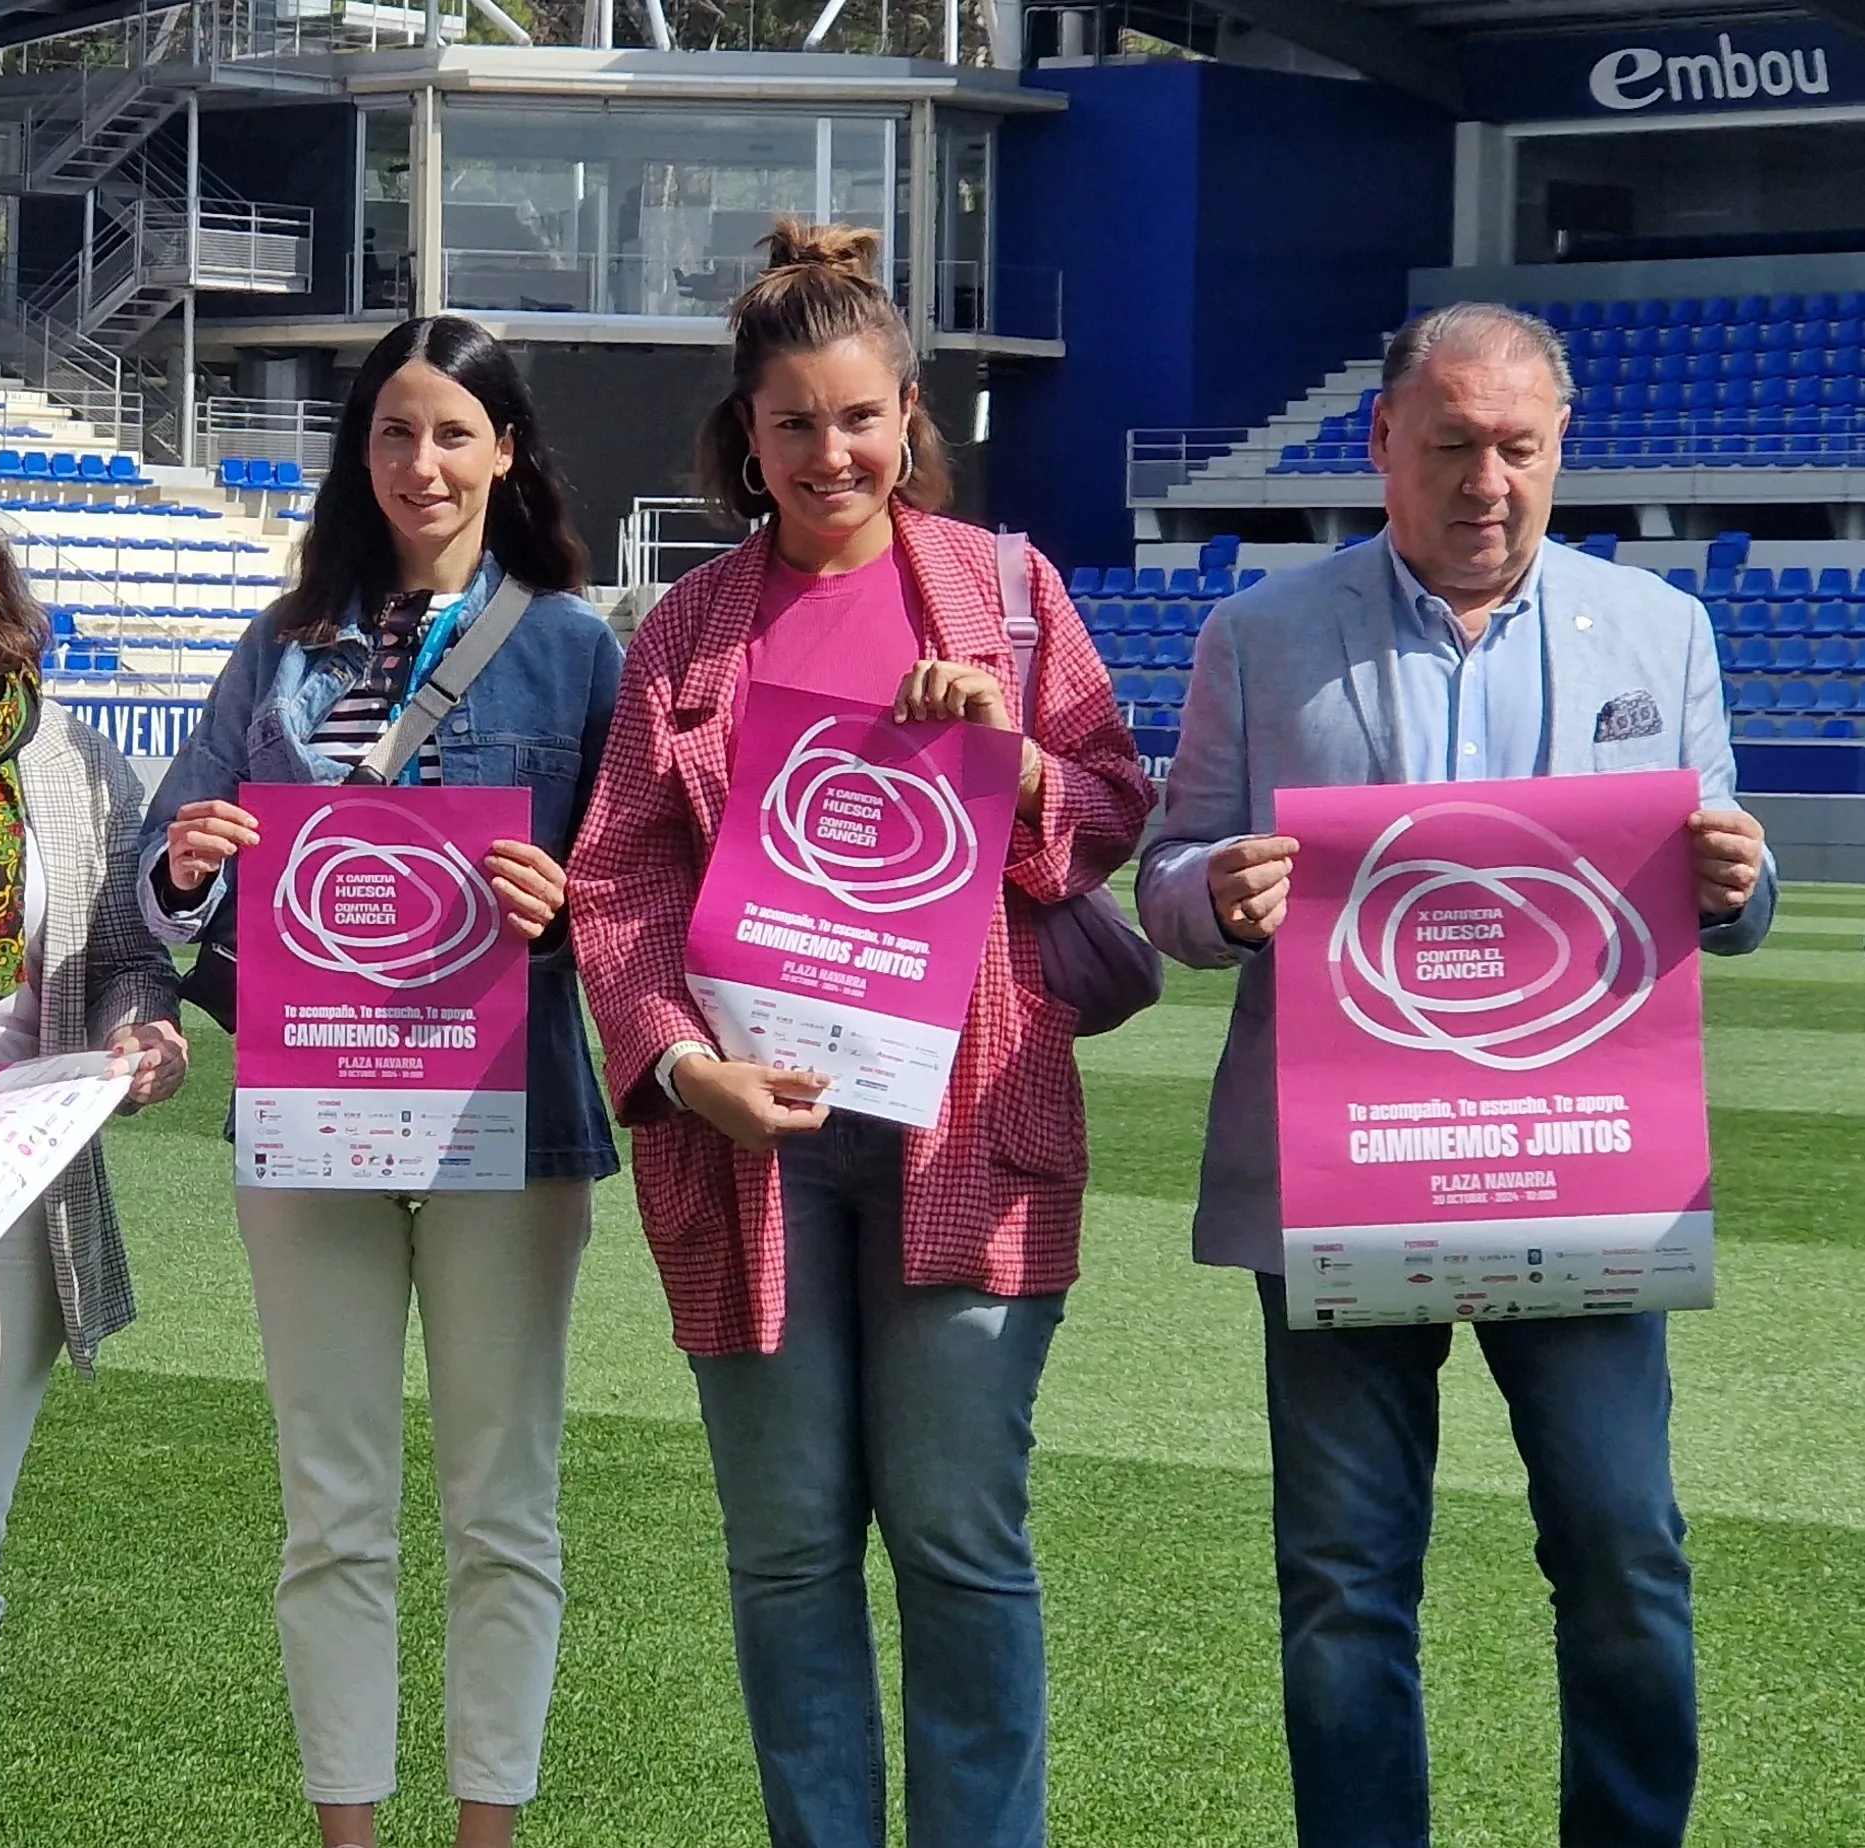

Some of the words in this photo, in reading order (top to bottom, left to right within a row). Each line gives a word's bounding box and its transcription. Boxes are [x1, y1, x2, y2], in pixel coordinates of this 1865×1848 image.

[1589, 33, 1830, 110] embou
[836, 789, 884, 807] CARRERA
[823, 799, 882, 820] HUESCA
[819, 816, 863, 832] CONTRA
[865, 825, 878, 836] EL
[817, 826, 877, 848] CANCER
[346, 874, 396, 884] CARRERA
[335, 886, 396, 898] HUESCA
[335, 904, 380, 913] CONTRA
[383, 904, 396, 913] EL
[1418, 910, 1429, 921] X
[1433, 908, 1503, 921] CARRERA
[335, 913, 396, 925] CANCER
[1417, 924, 1504, 941] HUESCA
[737, 919, 853, 964] CAMINEMOS
[855, 947, 927, 981] JUNTOS
[1417, 949, 1482, 964] CONTRA
[1484, 948, 1504, 960] EL
[783, 961, 817, 977] PLAZA
[819, 969, 867, 990] NAVARRA
[1417, 962, 1505, 981] CANCER
[284, 1023, 400, 1048] CAMINEMOS
[404, 1025, 476, 1049] JUNTOS
[338, 1057, 373, 1069] PLAZA
[375, 1057, 424, 1069] NAVARRA
[1348, 1102, 1367, 1121] Te
[1457, 1098, 1477, 1117] Te
[1553, 1095, 1572, 1113] Te
[1350, 1123, 1519, 1164] CAMINEMOS
[1526, 1119, 1631, 1156] JUNTOS
[1431, 1173, 1481, 1192] PLAZA
[1484, 1170, 1557, 1189] NAVARRA
